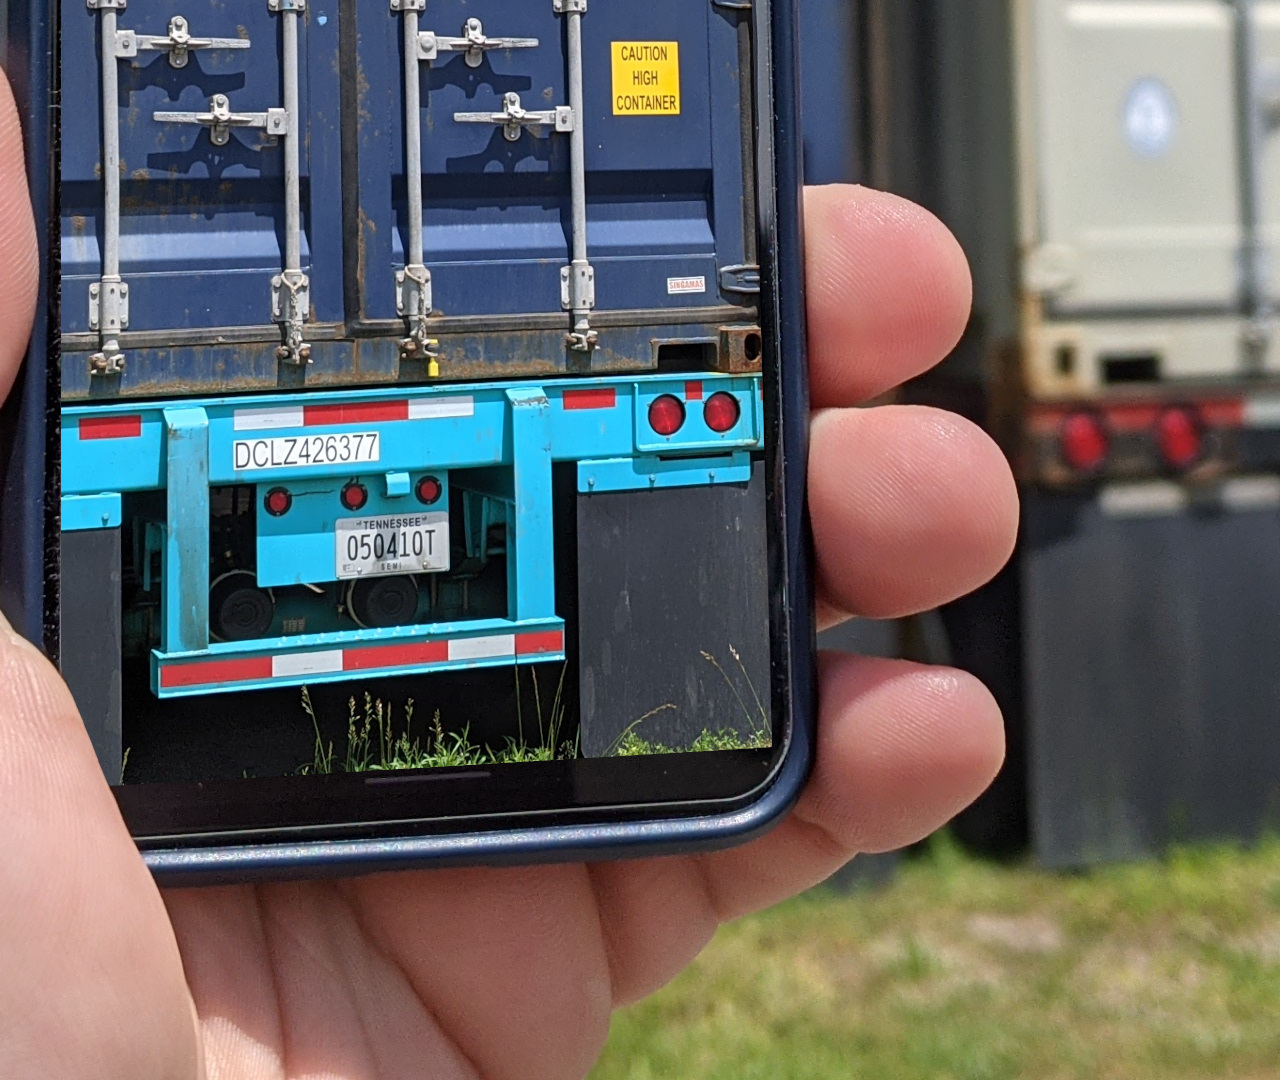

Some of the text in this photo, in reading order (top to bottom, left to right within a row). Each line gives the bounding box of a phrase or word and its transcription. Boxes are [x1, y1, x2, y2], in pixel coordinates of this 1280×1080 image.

[620, 45, 668, 61] CAUTION
[632, 70, 659, 86] HIGH
[616, 94, 677, 111] CONTAINER
[669, 280, 704, 290] SINGAMAS
[234, 433, 378, 469] DCLZ426377
[363, 517, 421, 530] TENNESSEE
[347, 529, 436, 561] 050410T
[380, 562, 402, 572] SEMI
